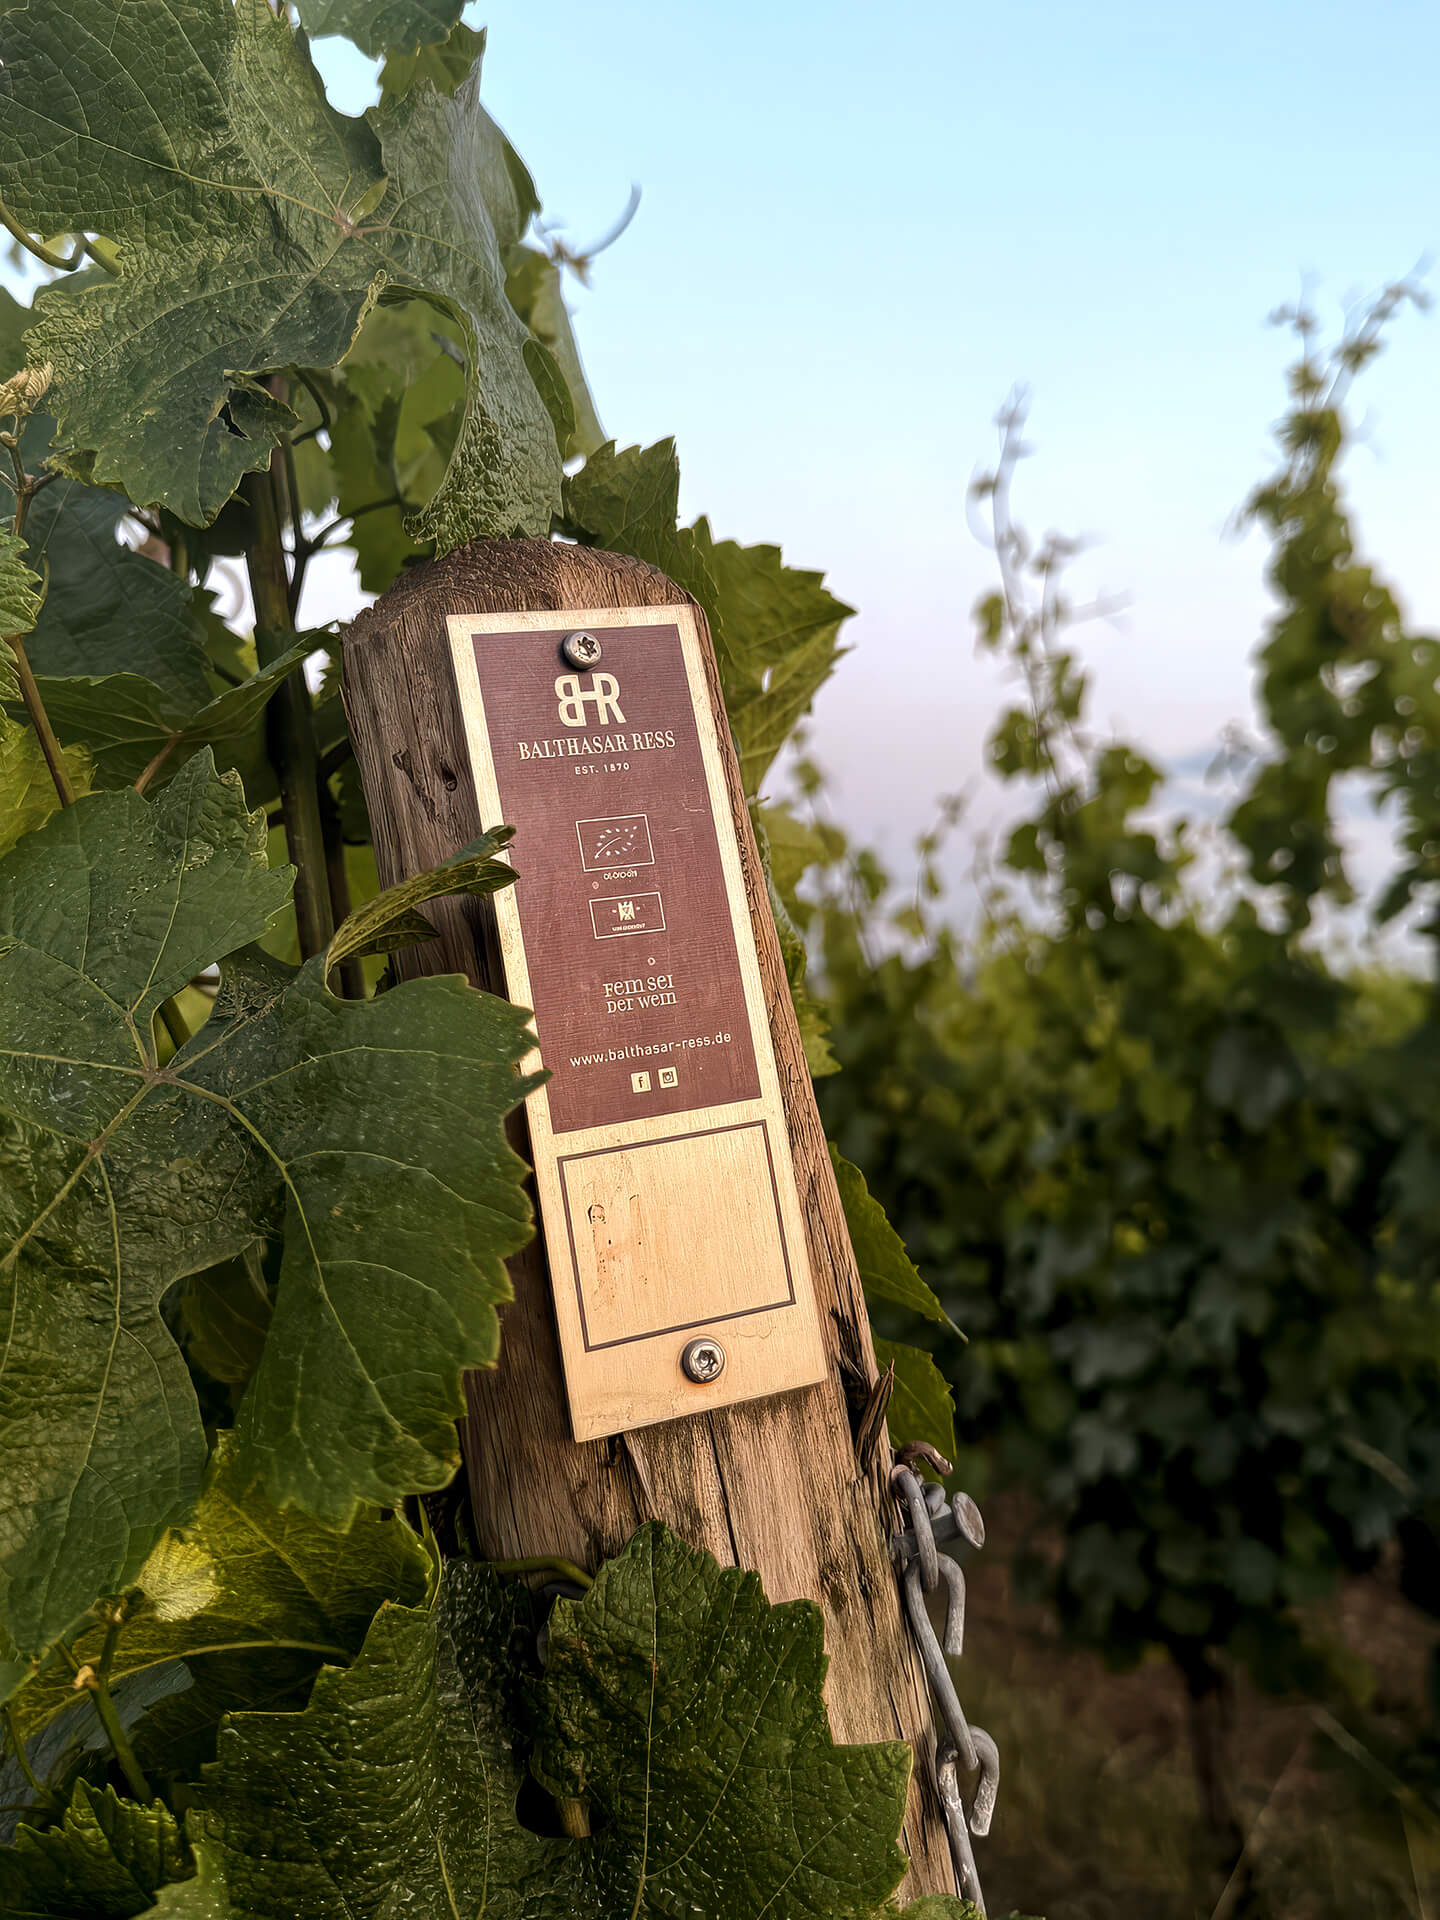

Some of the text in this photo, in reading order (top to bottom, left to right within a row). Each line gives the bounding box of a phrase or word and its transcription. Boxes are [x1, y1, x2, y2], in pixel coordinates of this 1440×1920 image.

[518, 730, 676, 761] BALTHASAR RESS
[574, 762, 630, 775] EST. 1870
[569, 1031, 732, 1067] www.balthasar-ress.de
